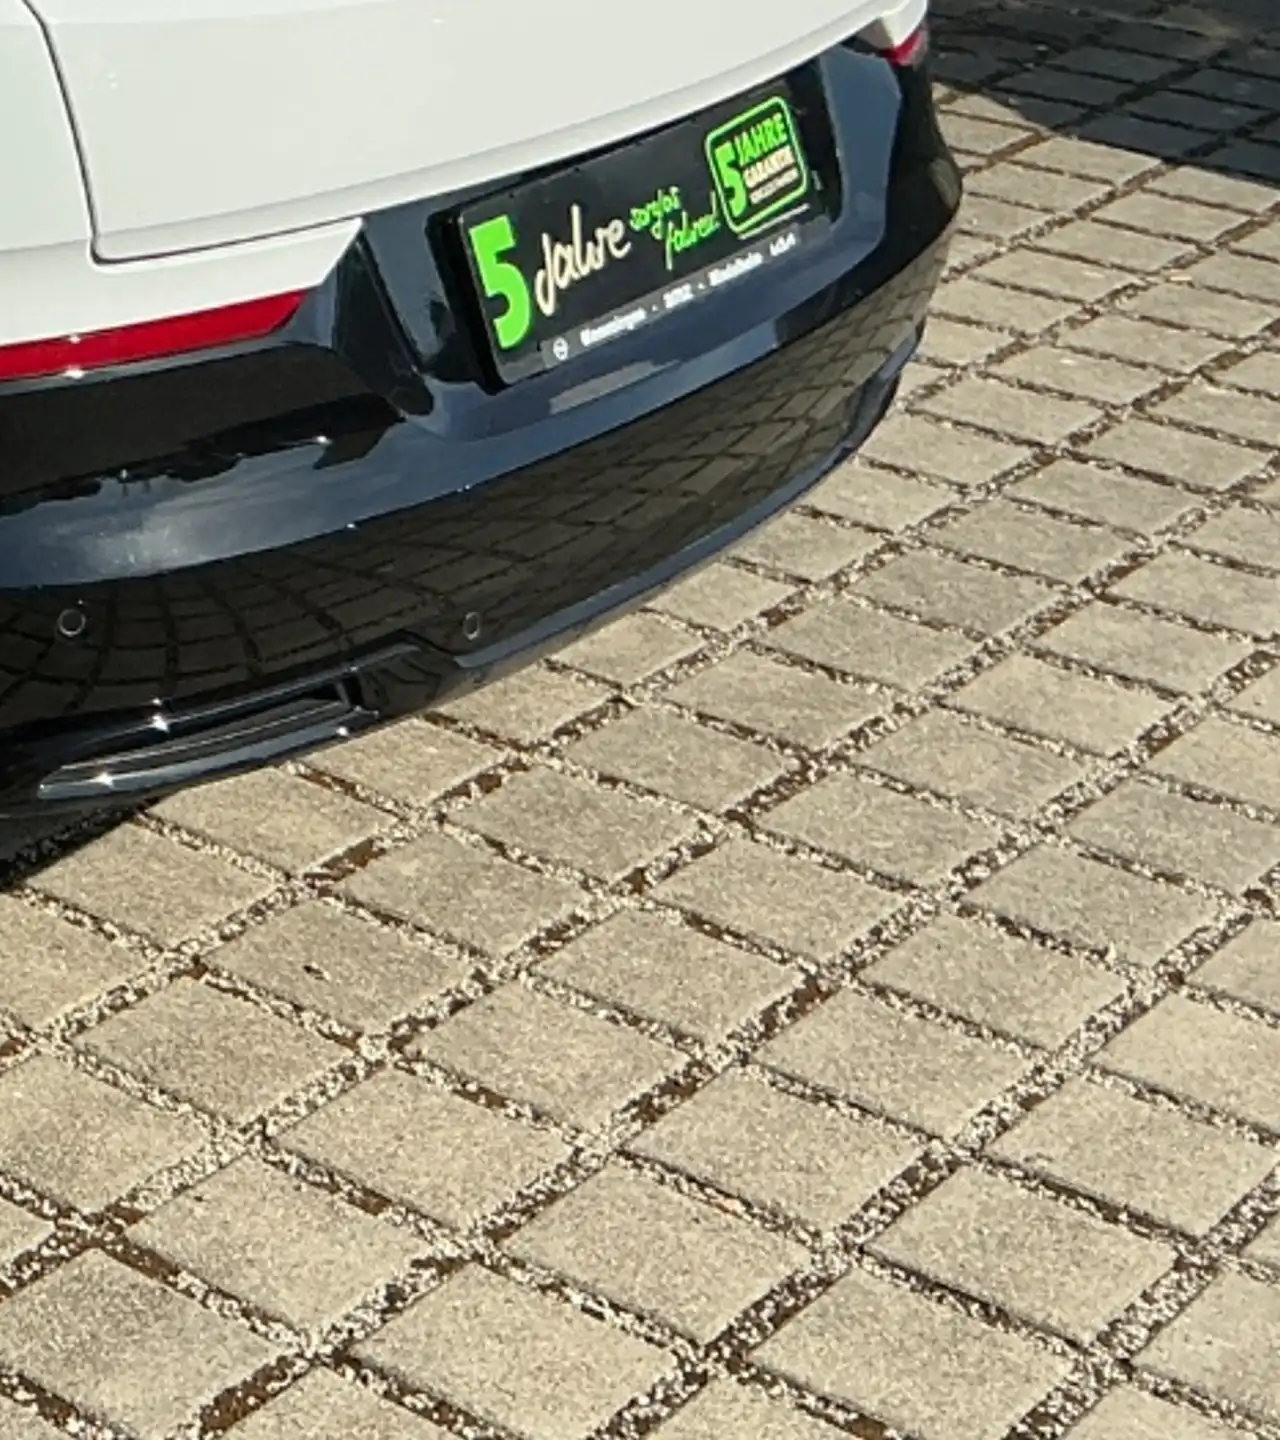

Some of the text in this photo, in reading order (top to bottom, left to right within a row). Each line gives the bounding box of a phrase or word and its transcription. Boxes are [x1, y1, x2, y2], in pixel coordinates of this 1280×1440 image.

[713, 141, 747, 218] 5
[734, 112, 788, 167] JAHRE
[468, 214, 532, 351] 5
